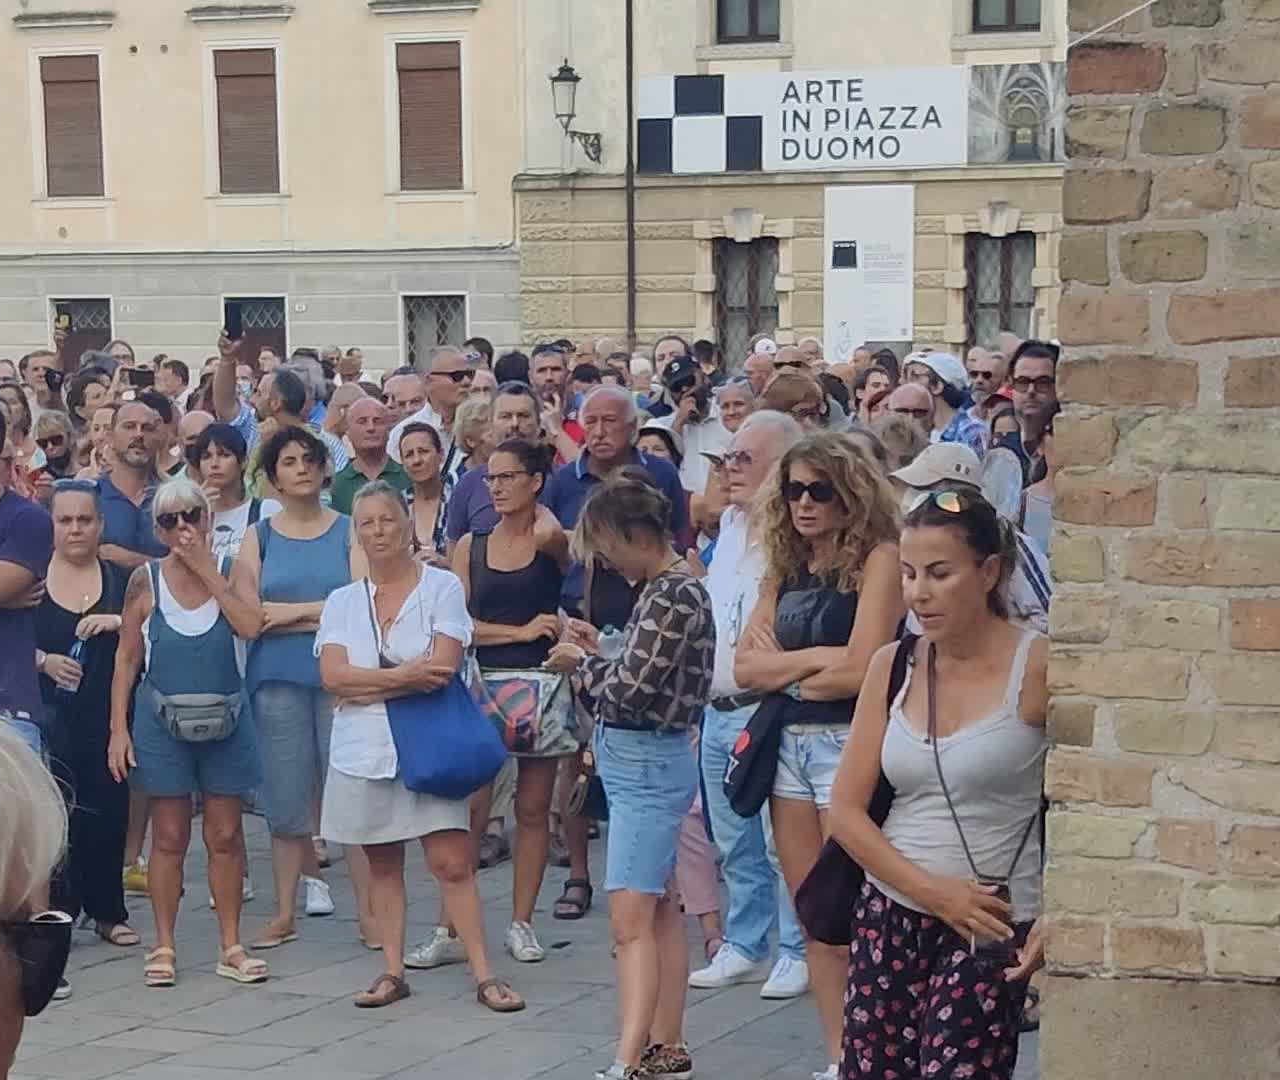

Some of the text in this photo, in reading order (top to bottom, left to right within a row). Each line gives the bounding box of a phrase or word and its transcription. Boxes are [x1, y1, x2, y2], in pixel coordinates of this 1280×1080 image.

[781, 79, 864, 104] ARTE
[782, 105, 943, 133] IN PIAZZA
[781, 136, 901, 161] DUOMO
